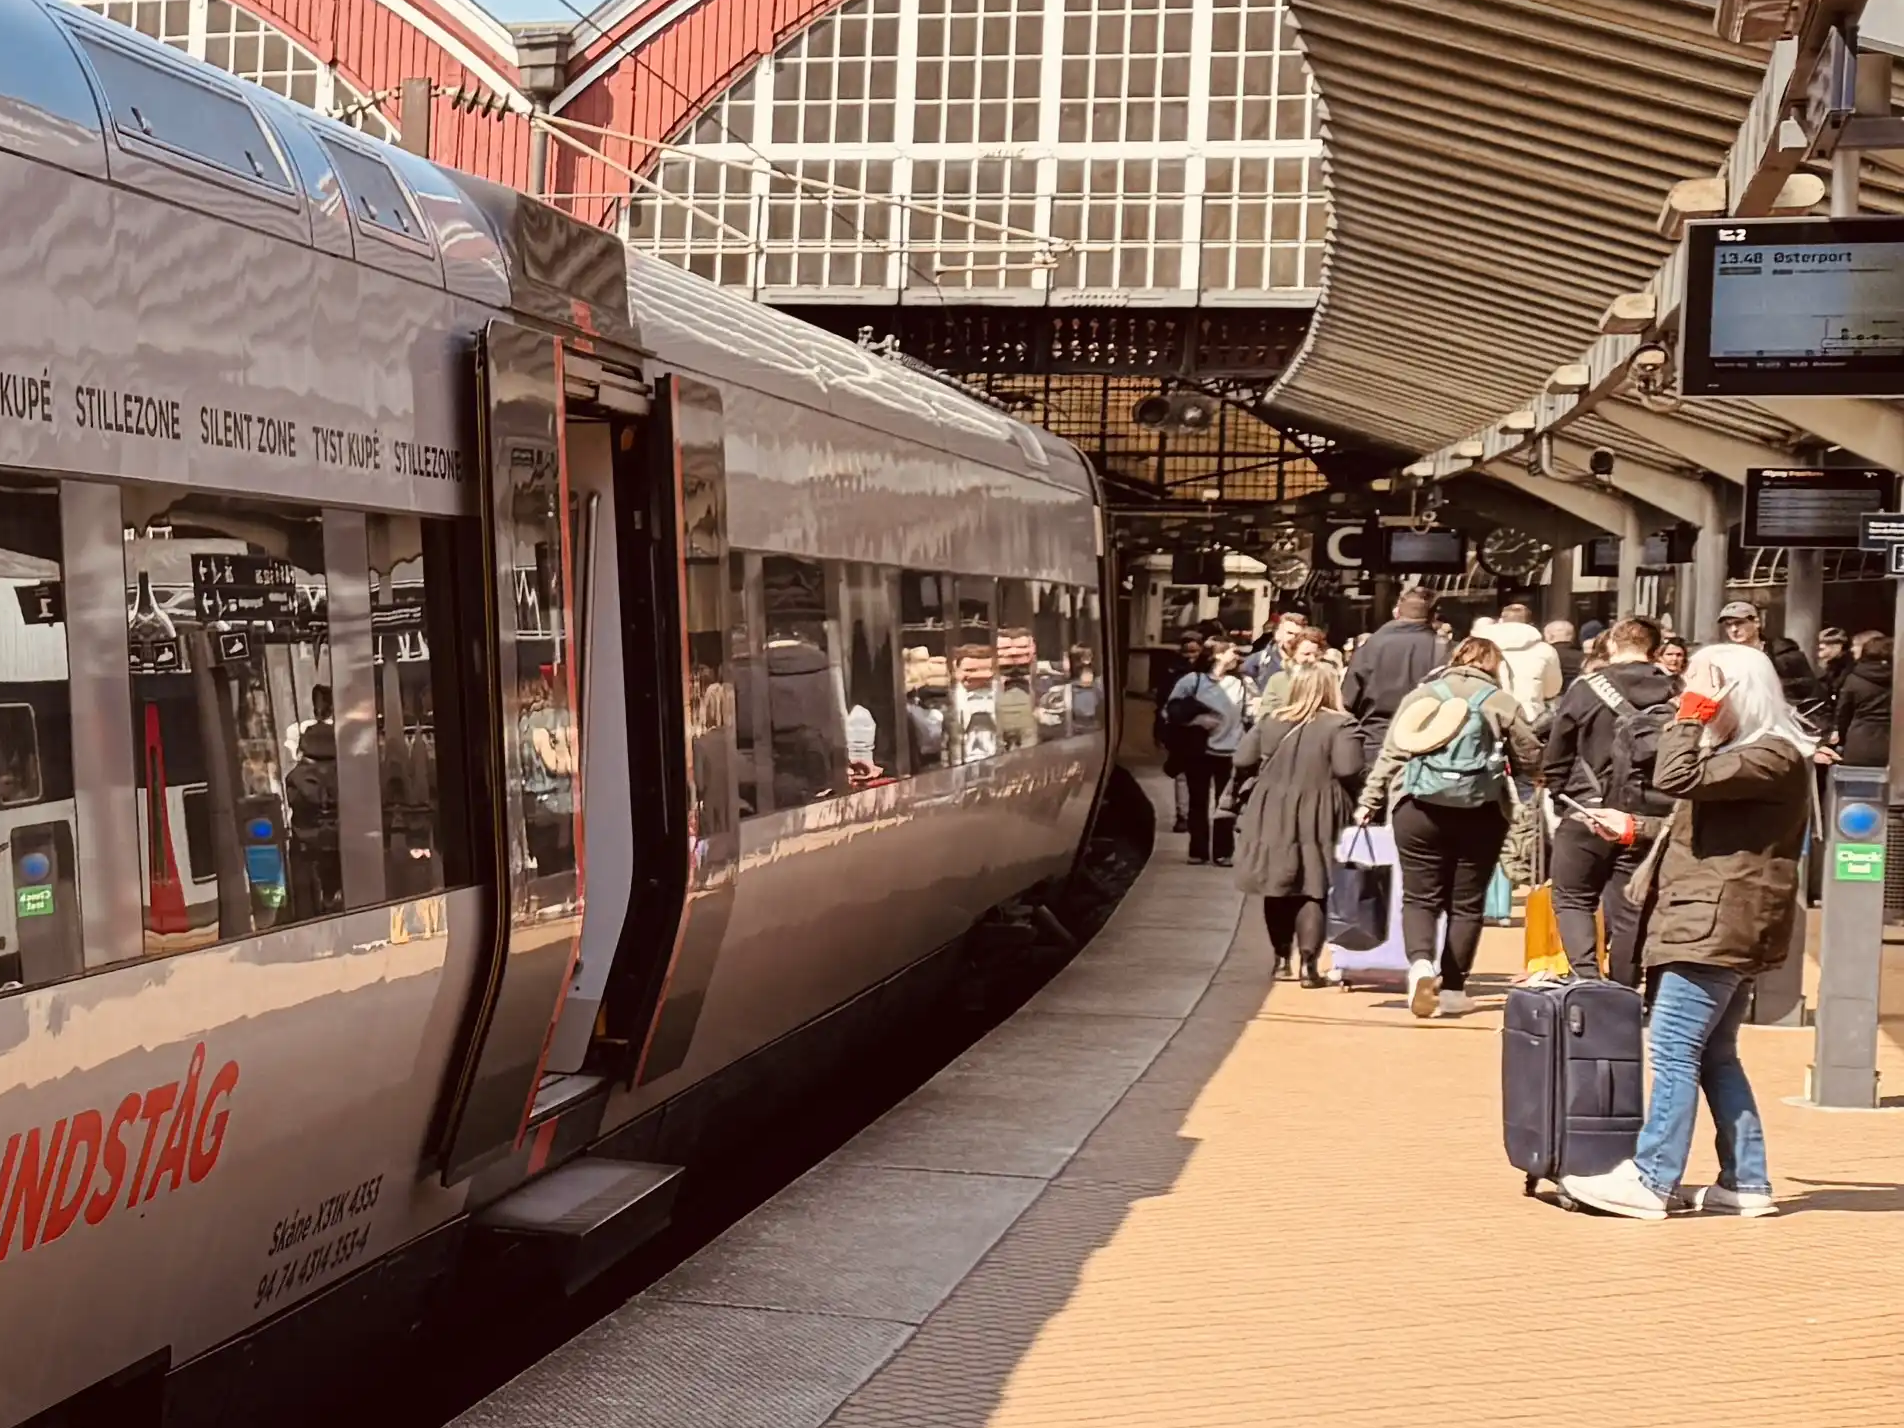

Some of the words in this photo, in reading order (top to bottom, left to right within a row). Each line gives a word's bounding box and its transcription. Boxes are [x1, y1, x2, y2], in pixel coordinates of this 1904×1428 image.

[1773, 251, 1853, 265] Østerport
[0, 367, 53, 423] KUPÉ
[74, 384, 182, 442] STILLEZONE
[199, 405, 253, 452] SILENT
[256, 414, 297, 459] ZONE
[312, 425, 346, 465] TYST
[346, 428, 382, 470] KUPÉ
[394, 441, 462, 483] STILLEZONE
[1326, 526, 1364, 567] C
[268, 1208, 312, 1256] Skåne
[348, 1173, 384, 1218] 4353
[254, 1269, 278, 1309] 94
